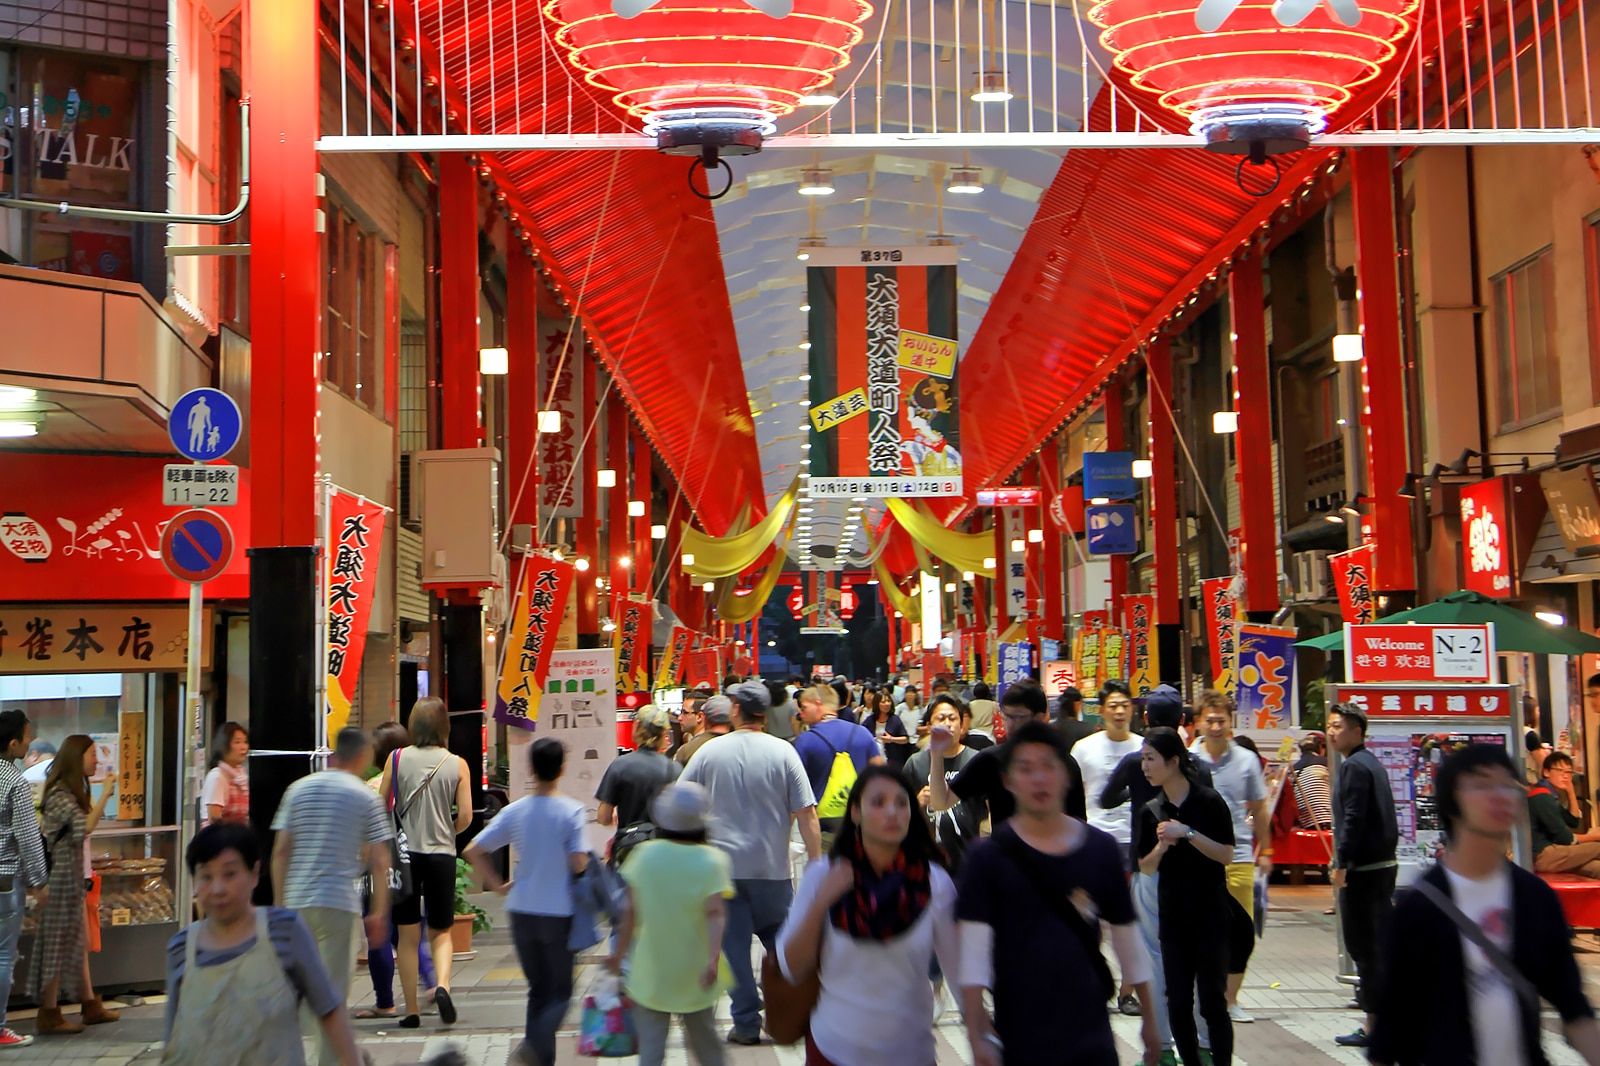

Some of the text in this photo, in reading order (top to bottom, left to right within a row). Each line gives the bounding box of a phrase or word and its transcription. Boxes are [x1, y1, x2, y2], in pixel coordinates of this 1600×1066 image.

[35, 127, 136, 172] TALK
[902, 336, 953, 358] おいらん
[910, 353, 938, 369] 道中
[865, 272, 902, 473] 大須大道町人祭
[814, 394, 867, 427] 大道芸
[167, 468, 236, 485] 軽車両を除く
[171, 487, 230, 503] 11-22
[2, 522, 40, 538] 大須
[56, 516, 171, 561] みたらし
[10, 539, 48, 554] 名物
[1364, 637, 1425, 651] Welcome
[1435, 635, 1483, 655] N-2
[1355, 654, 1387, 668] 환영
[1395, 654, 1432, 668] 欢迎
[1349, 695, 1500, 712] 仁王門通り
